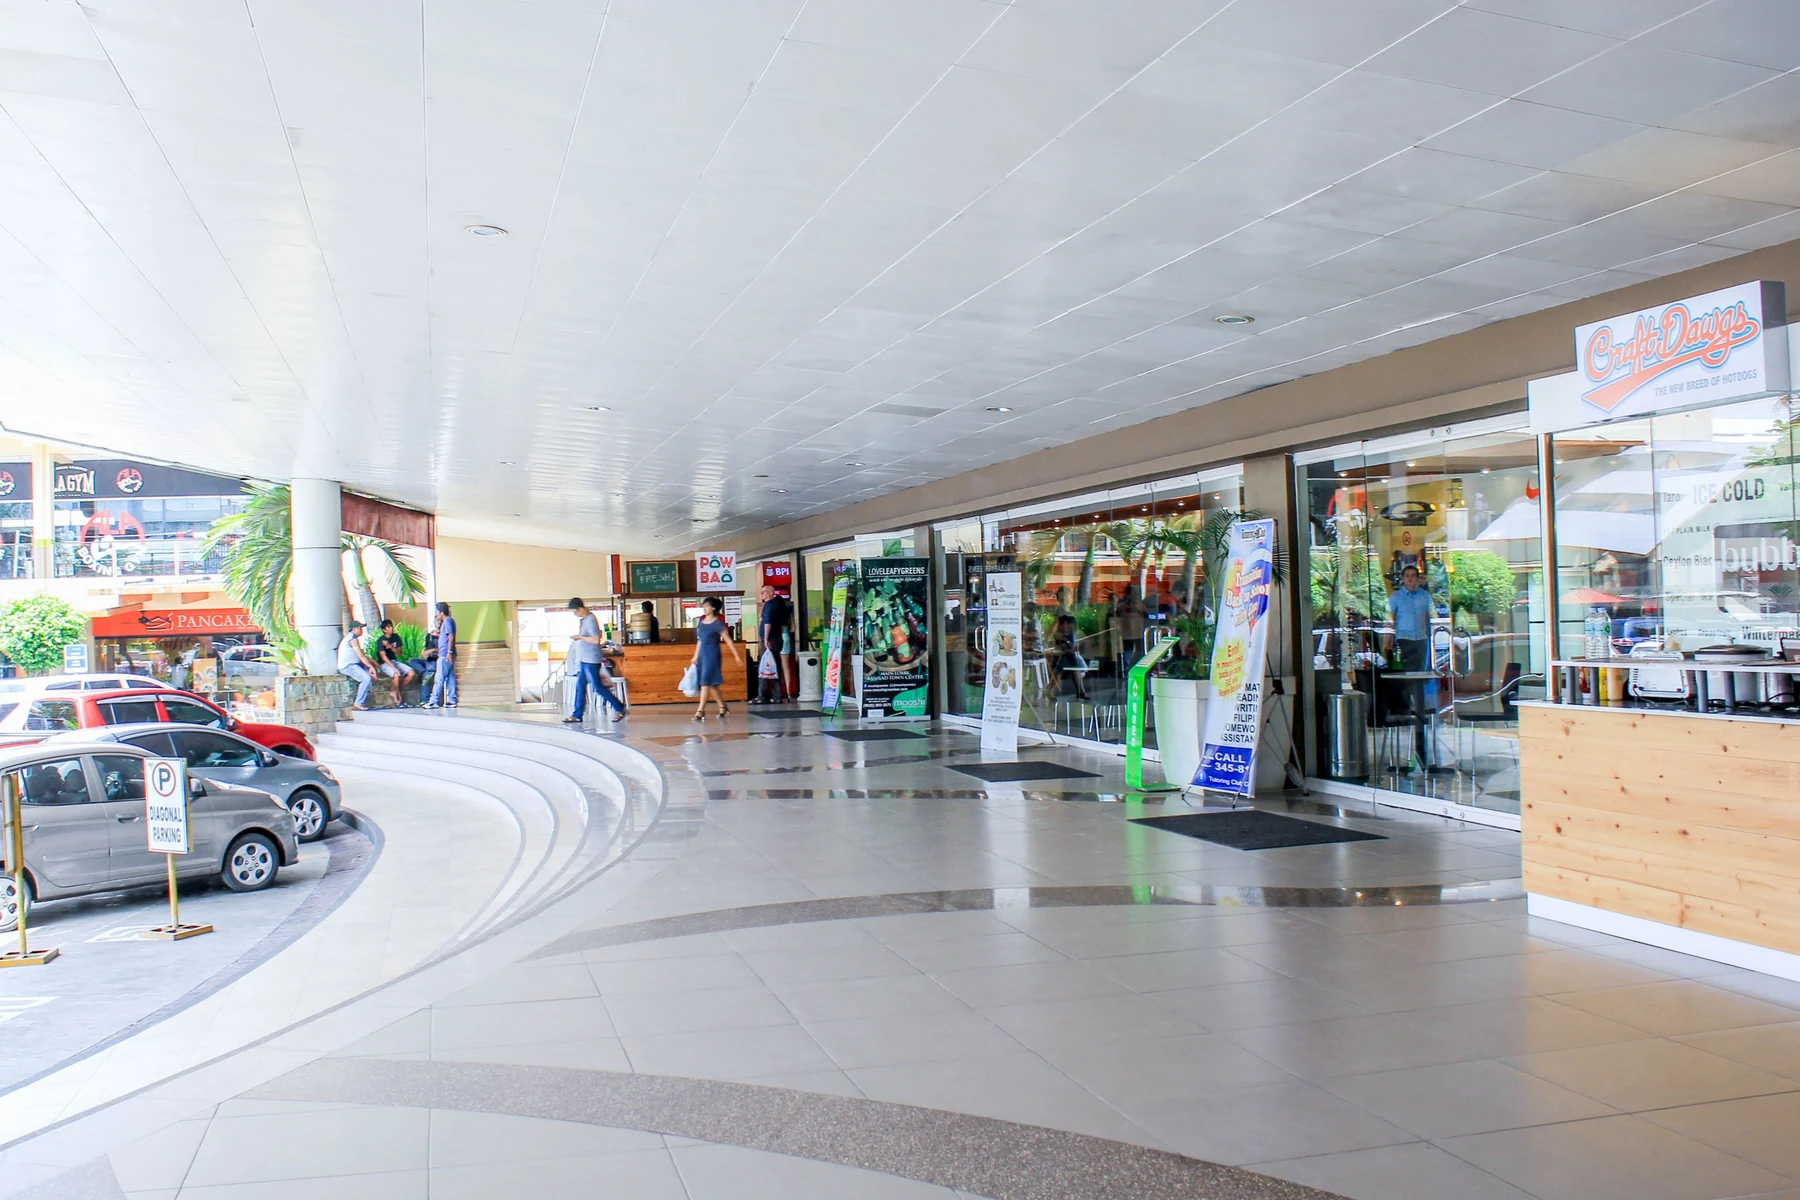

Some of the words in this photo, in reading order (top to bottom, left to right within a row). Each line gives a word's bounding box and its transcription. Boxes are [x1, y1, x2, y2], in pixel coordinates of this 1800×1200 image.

[1586, 315, 1658, 381] Craft
[1657, 302, 1752, 368] Dawgs
[1654, 386, 1668, 397] THE
[1669, 383, 1684, 395] NEW
[1686, 378, 1709, 392] BREED
[1711, 376, 1721, 387] OF
[1722, 369, 1757, 386] HOTDOGS
[66, 470, 95, 495] GYM
[1693, 484, 1717, 505] ICE
[1723, 478, 1765, 502] COLD
[1695, 524, 1711, 533] MILK
[637, 565, 660, 576] EAT
[699, 569, 733, 584] BAO
[775, 567, 790, 576] BPI
[894, 697, 926, 707] mooshi
[1214, 752, 1246, 764] CALL
[158, 768, 171, 791] P
[1208, 775, 1231, 786] Tutoring
[149, 805, 183, 823] DIAGONAL
[152, 826, 182, 844] PARKING
